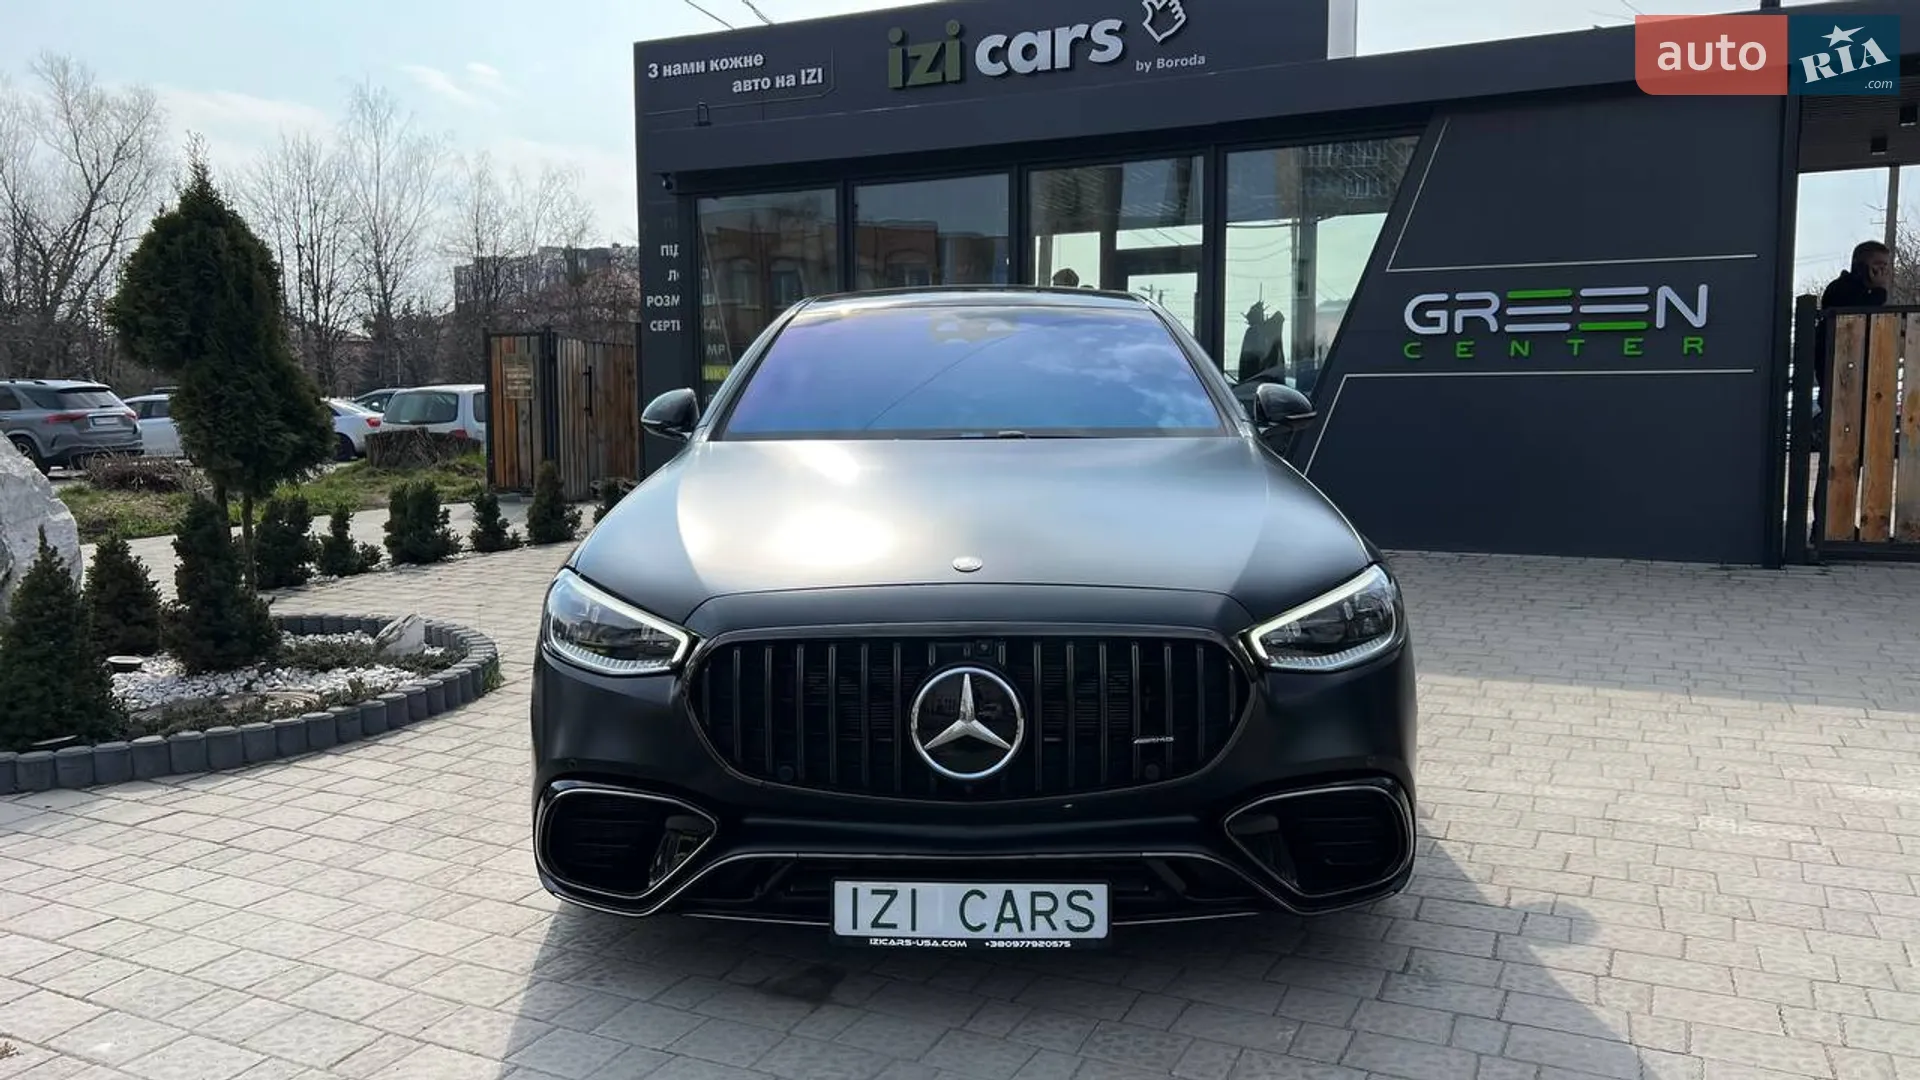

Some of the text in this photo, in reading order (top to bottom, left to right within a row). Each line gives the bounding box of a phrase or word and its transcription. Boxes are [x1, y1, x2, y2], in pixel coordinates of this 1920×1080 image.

[662, 59, 706, 77] нами
[709, 53, 764, 72] кожне
[888, 18, 1124, 89] izi cars
[1135, 53, 1206, 72] by Boroda
[732, 67, 823, 93] авто на IZI
[1403, 284, 1708, 334] GREEN
[1404, 336, 1704, 359] CENTER
[852, 887, 1095, 933] IZI CARS
